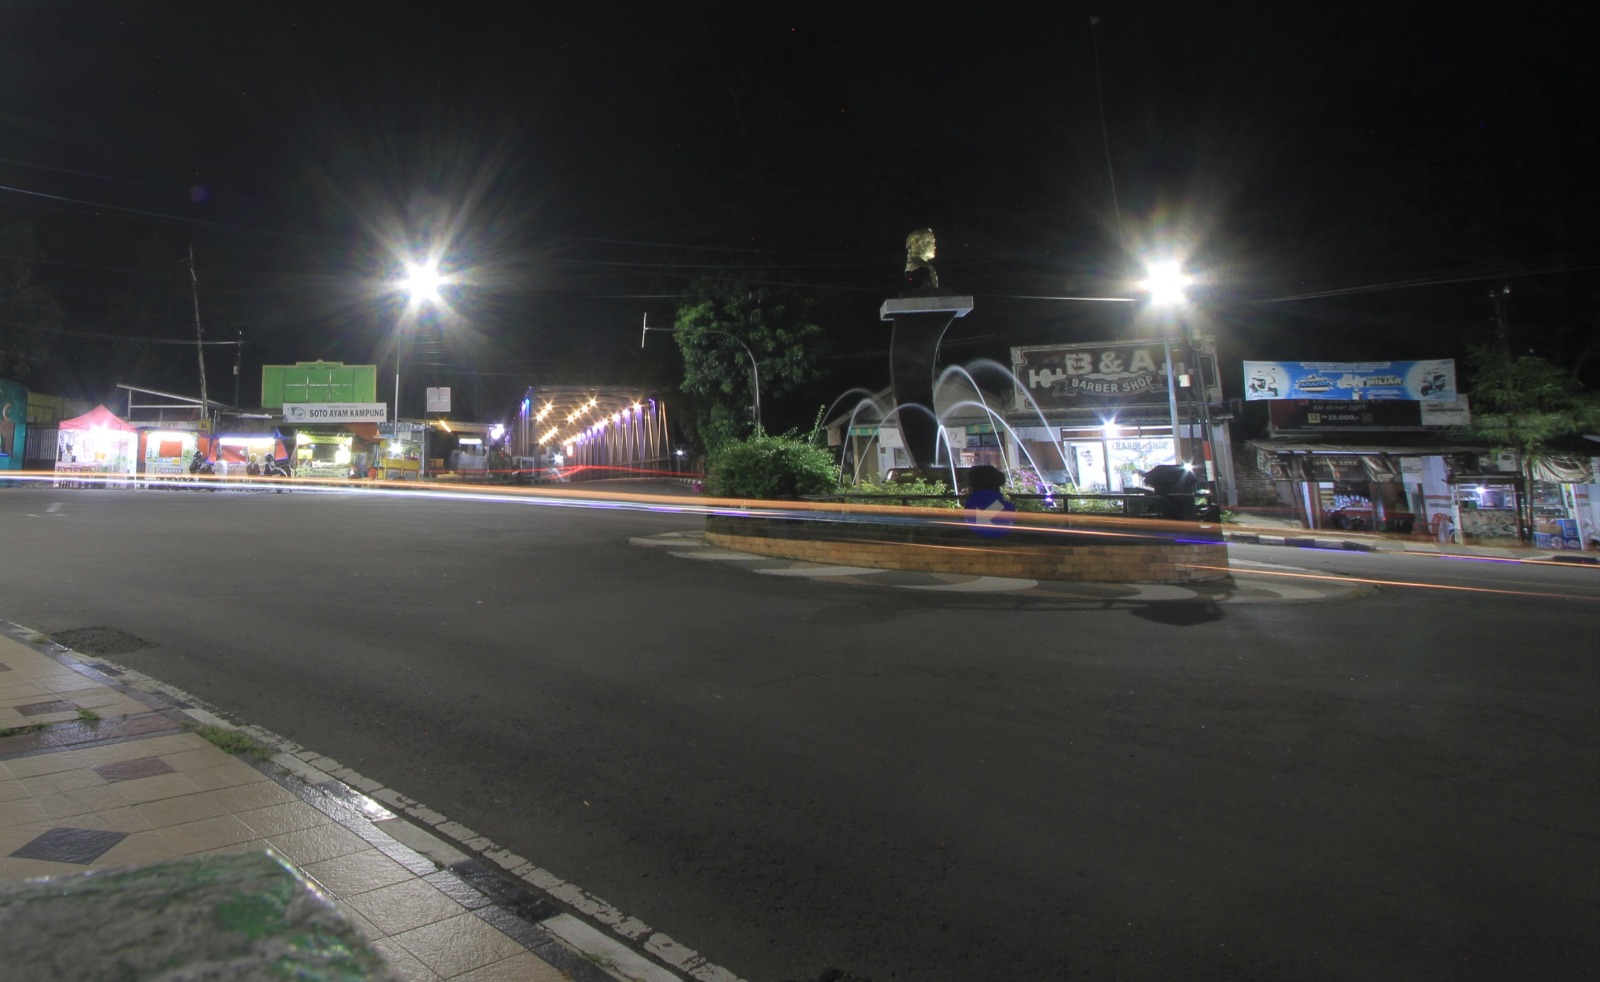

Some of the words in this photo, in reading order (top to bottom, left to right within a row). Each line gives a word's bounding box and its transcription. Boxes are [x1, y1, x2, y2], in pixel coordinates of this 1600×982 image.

[1065, 352, 1093, 375] B
[1099, 350, 1123, 374] &
[1129, 348, 1157, 372] A
[1071, 377, 1119, 393] BARBER
[1122, 375, 1154, 392] SHOP
[309, 409, 327, 418] SOTO
[329, 408, 348, 418] AYAM
[349, 408, 384, 418] KAMPUNG
